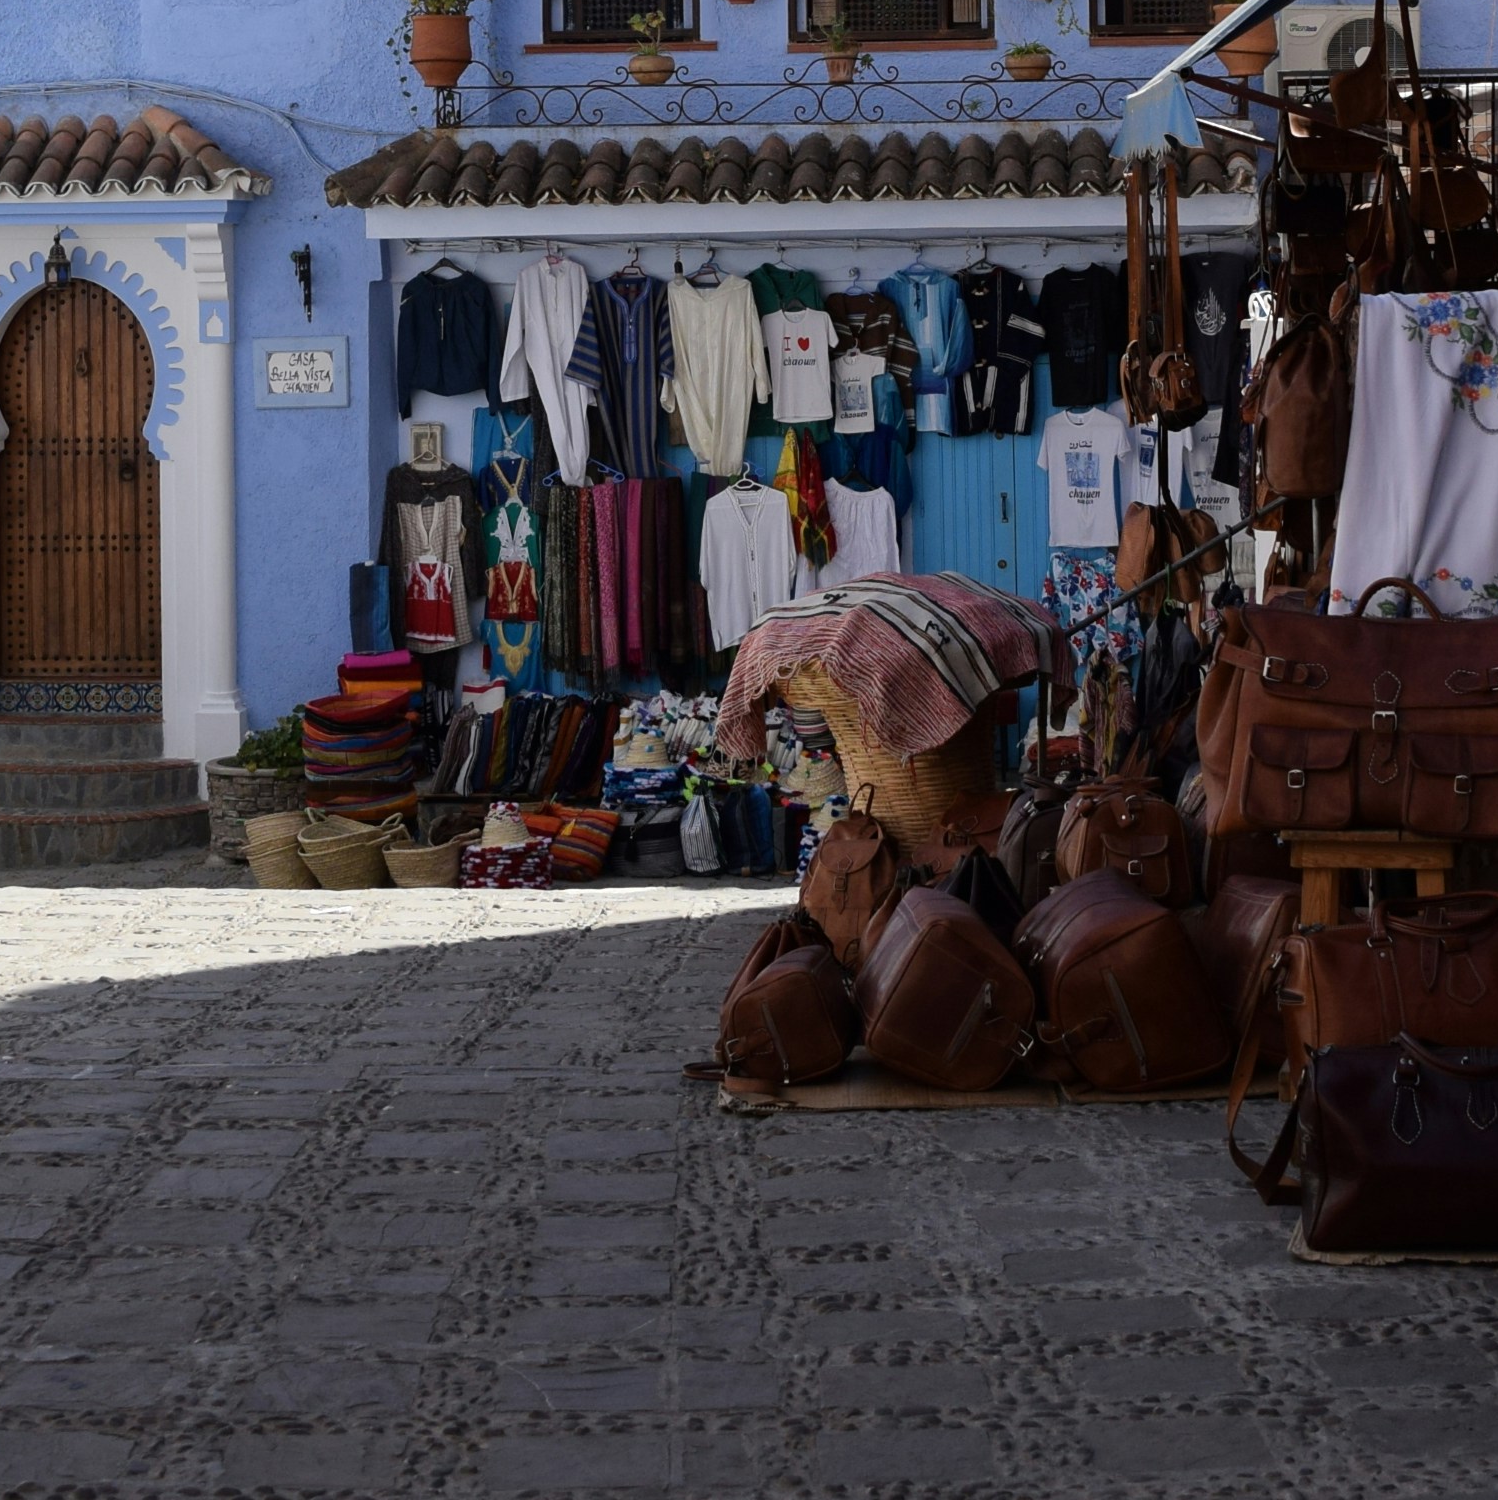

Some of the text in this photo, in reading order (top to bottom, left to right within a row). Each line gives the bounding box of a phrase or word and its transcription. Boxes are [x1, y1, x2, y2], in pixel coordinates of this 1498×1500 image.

[783, 336, 791, 351] I
[288, 352, 318, 367] CASA
[270, 366, 300, 382] BELLA
[1195, 495, 1230, 504] haouen
